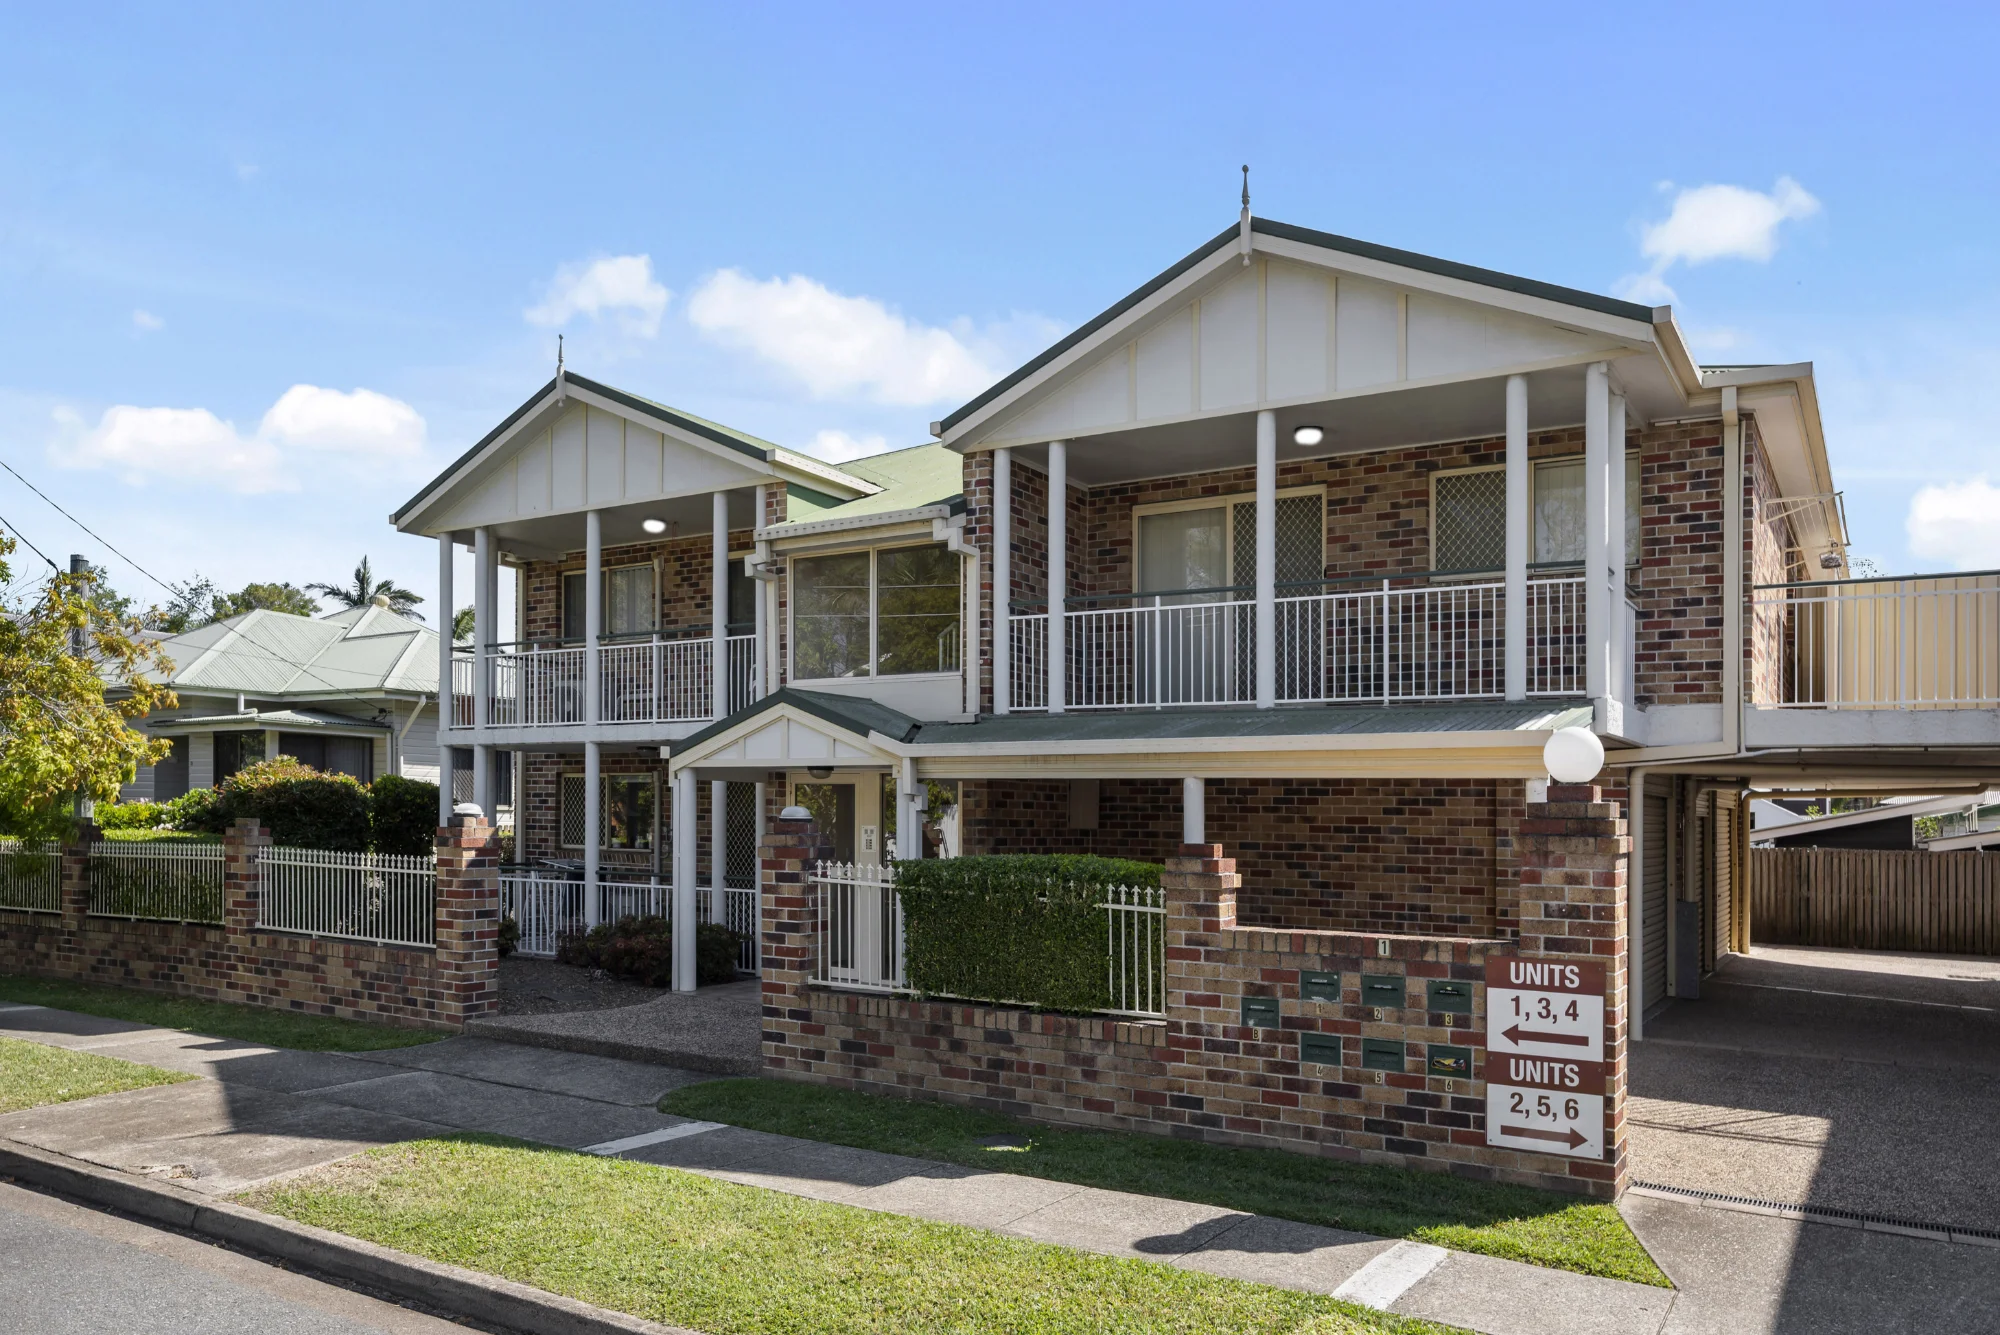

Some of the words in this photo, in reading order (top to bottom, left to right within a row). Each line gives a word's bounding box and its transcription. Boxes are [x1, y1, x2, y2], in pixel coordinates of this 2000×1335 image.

[1509, 961, 1580, 989] UNITS
[1446, 1014, 1452, 1025] 3
[1253, 1029, 1259, 1039] B
[1509, 1058, 1580, 1087] UNITS
[1446, 1080, 1452, 1091] 6
